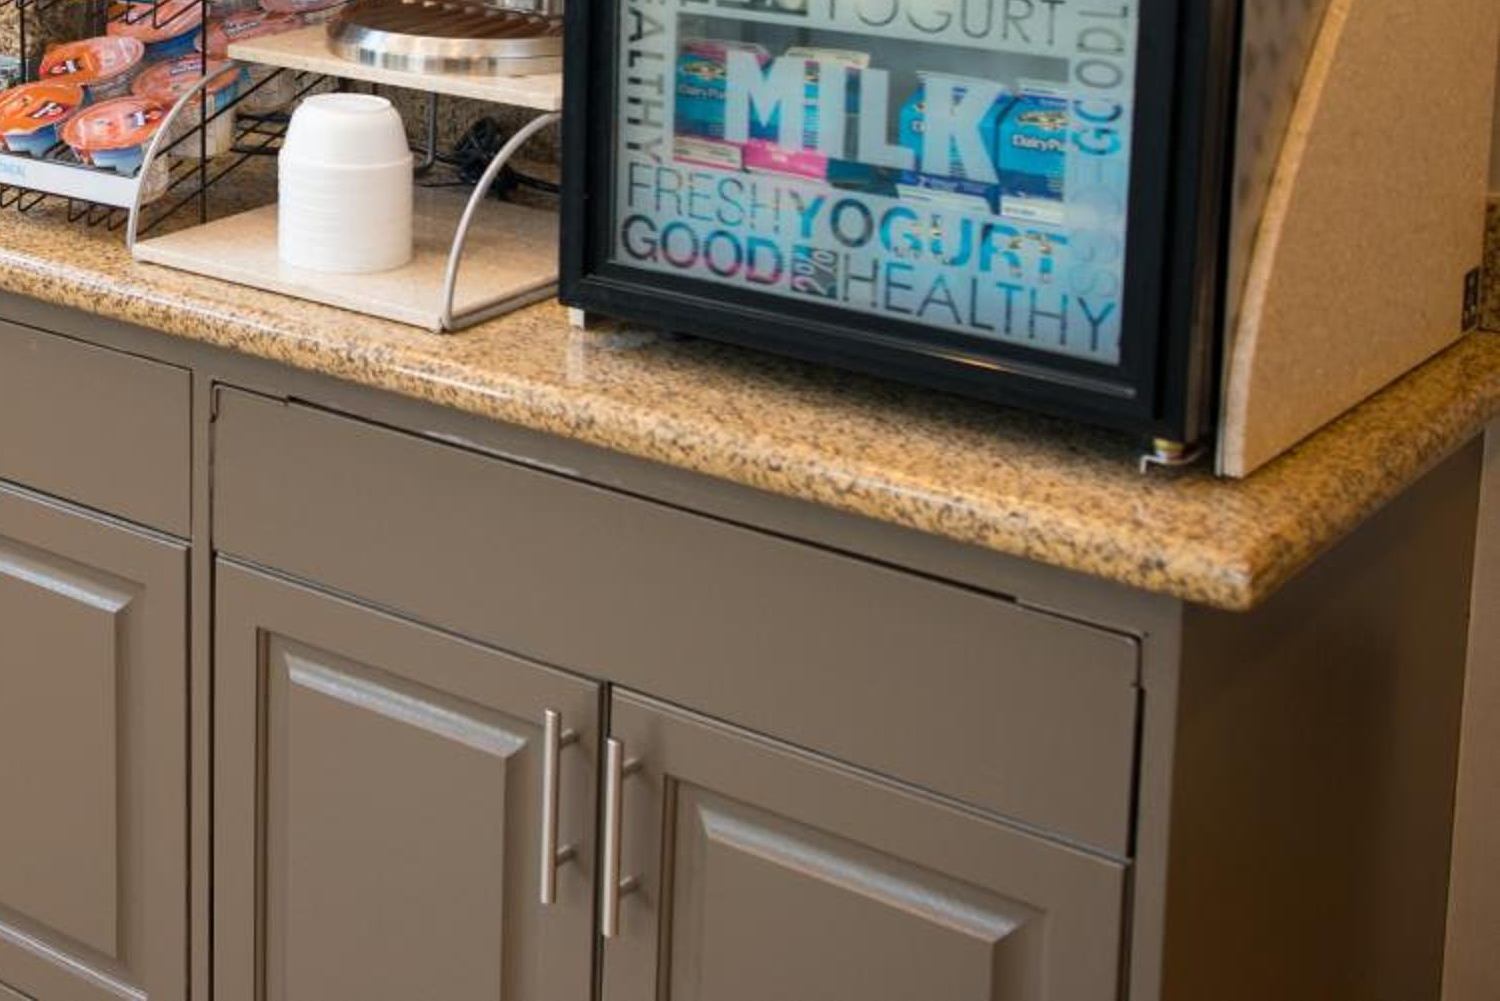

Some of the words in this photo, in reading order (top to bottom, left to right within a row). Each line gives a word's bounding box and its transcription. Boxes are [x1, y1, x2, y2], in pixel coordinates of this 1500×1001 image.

[723, 49, 1008, 184] MILK
[1071, 26, 1126, 156] GOOD
[621, 214, 783, 285] GOOD
[843, 252, 1116, 352] HEALTHY
[627, 162, 780, 233] FRESH
[788, 188, 1068, 283] YOGURT
